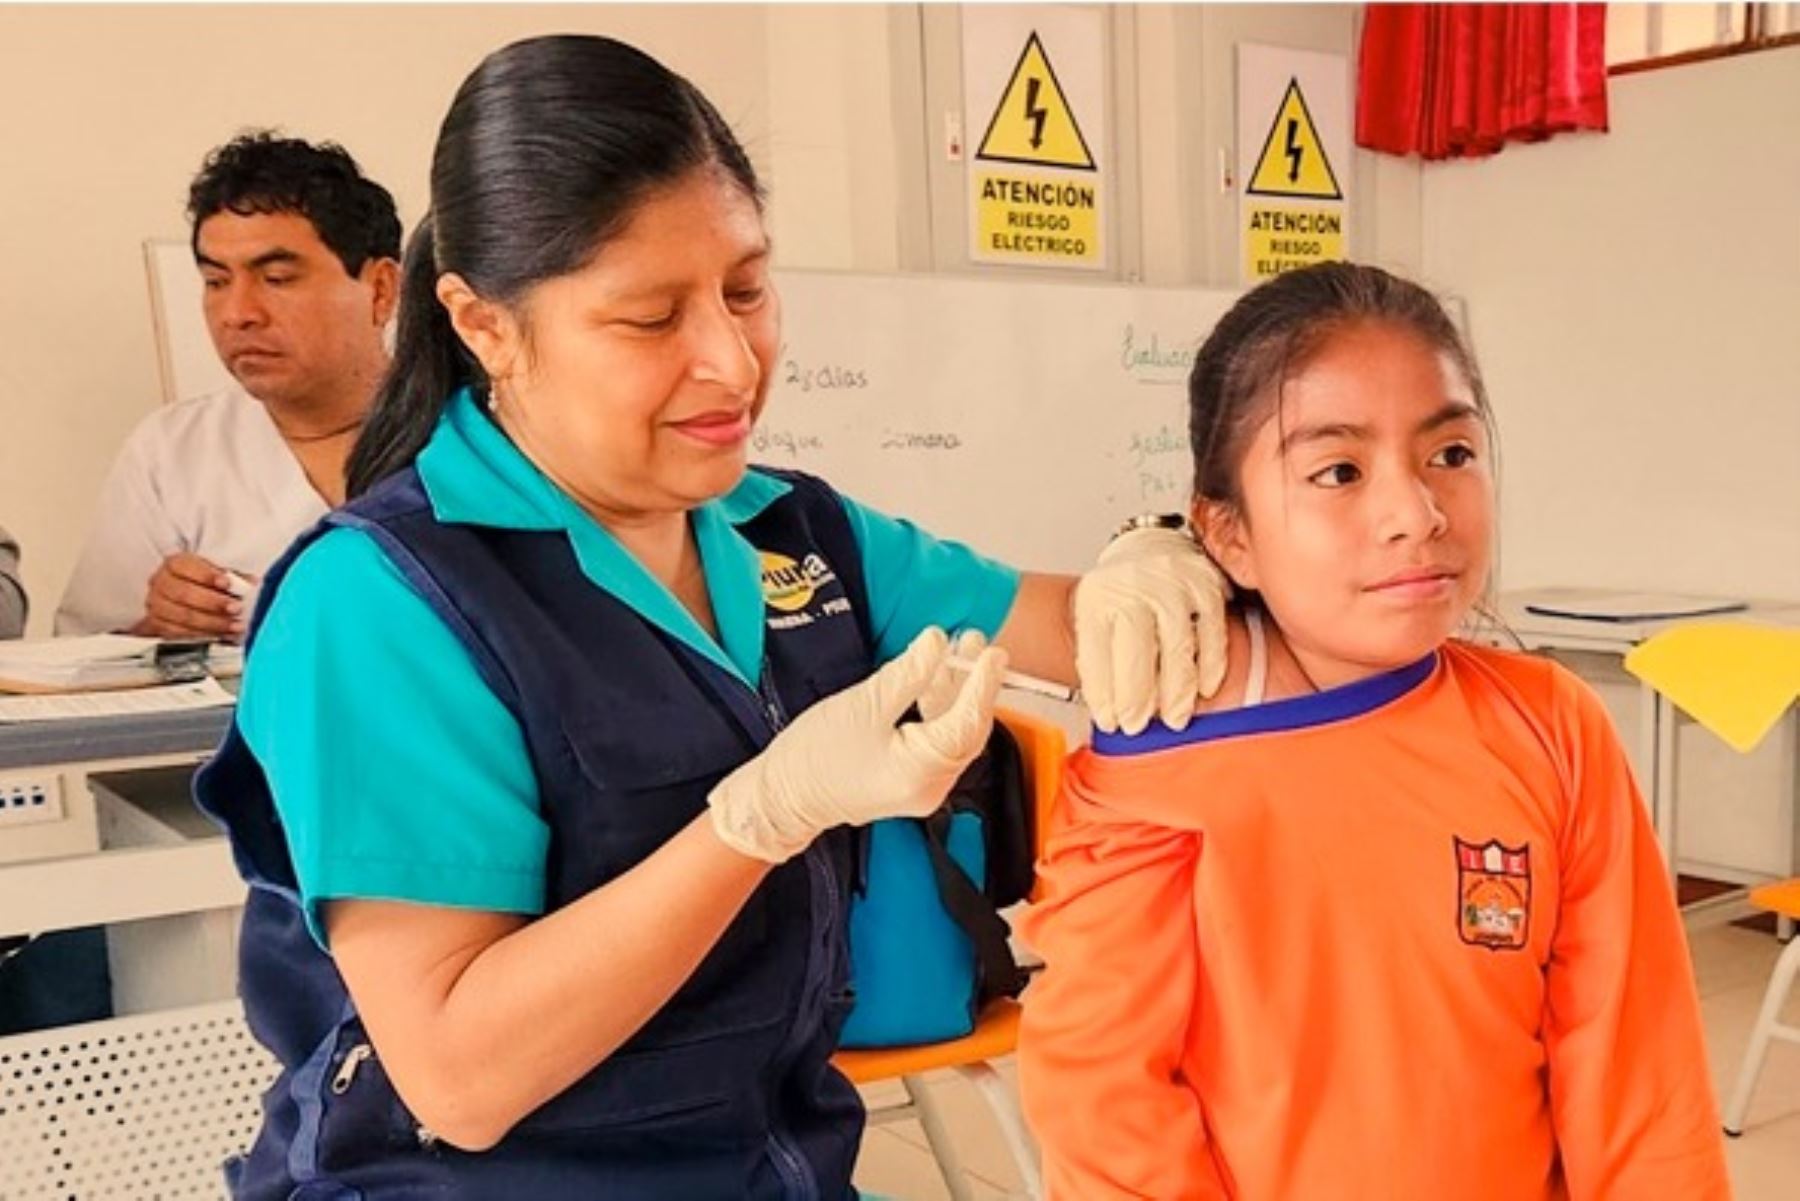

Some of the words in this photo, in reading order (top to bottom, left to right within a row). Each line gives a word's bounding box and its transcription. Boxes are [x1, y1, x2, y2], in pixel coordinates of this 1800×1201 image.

[982, 177, 1095, 208] ATENCIÓN
[1007, 211, 1070, 231] RIESGO
[1250, 210, 1341, 234] ATENCIÓN
[1269, 239, 1322, 255] RIESGO
